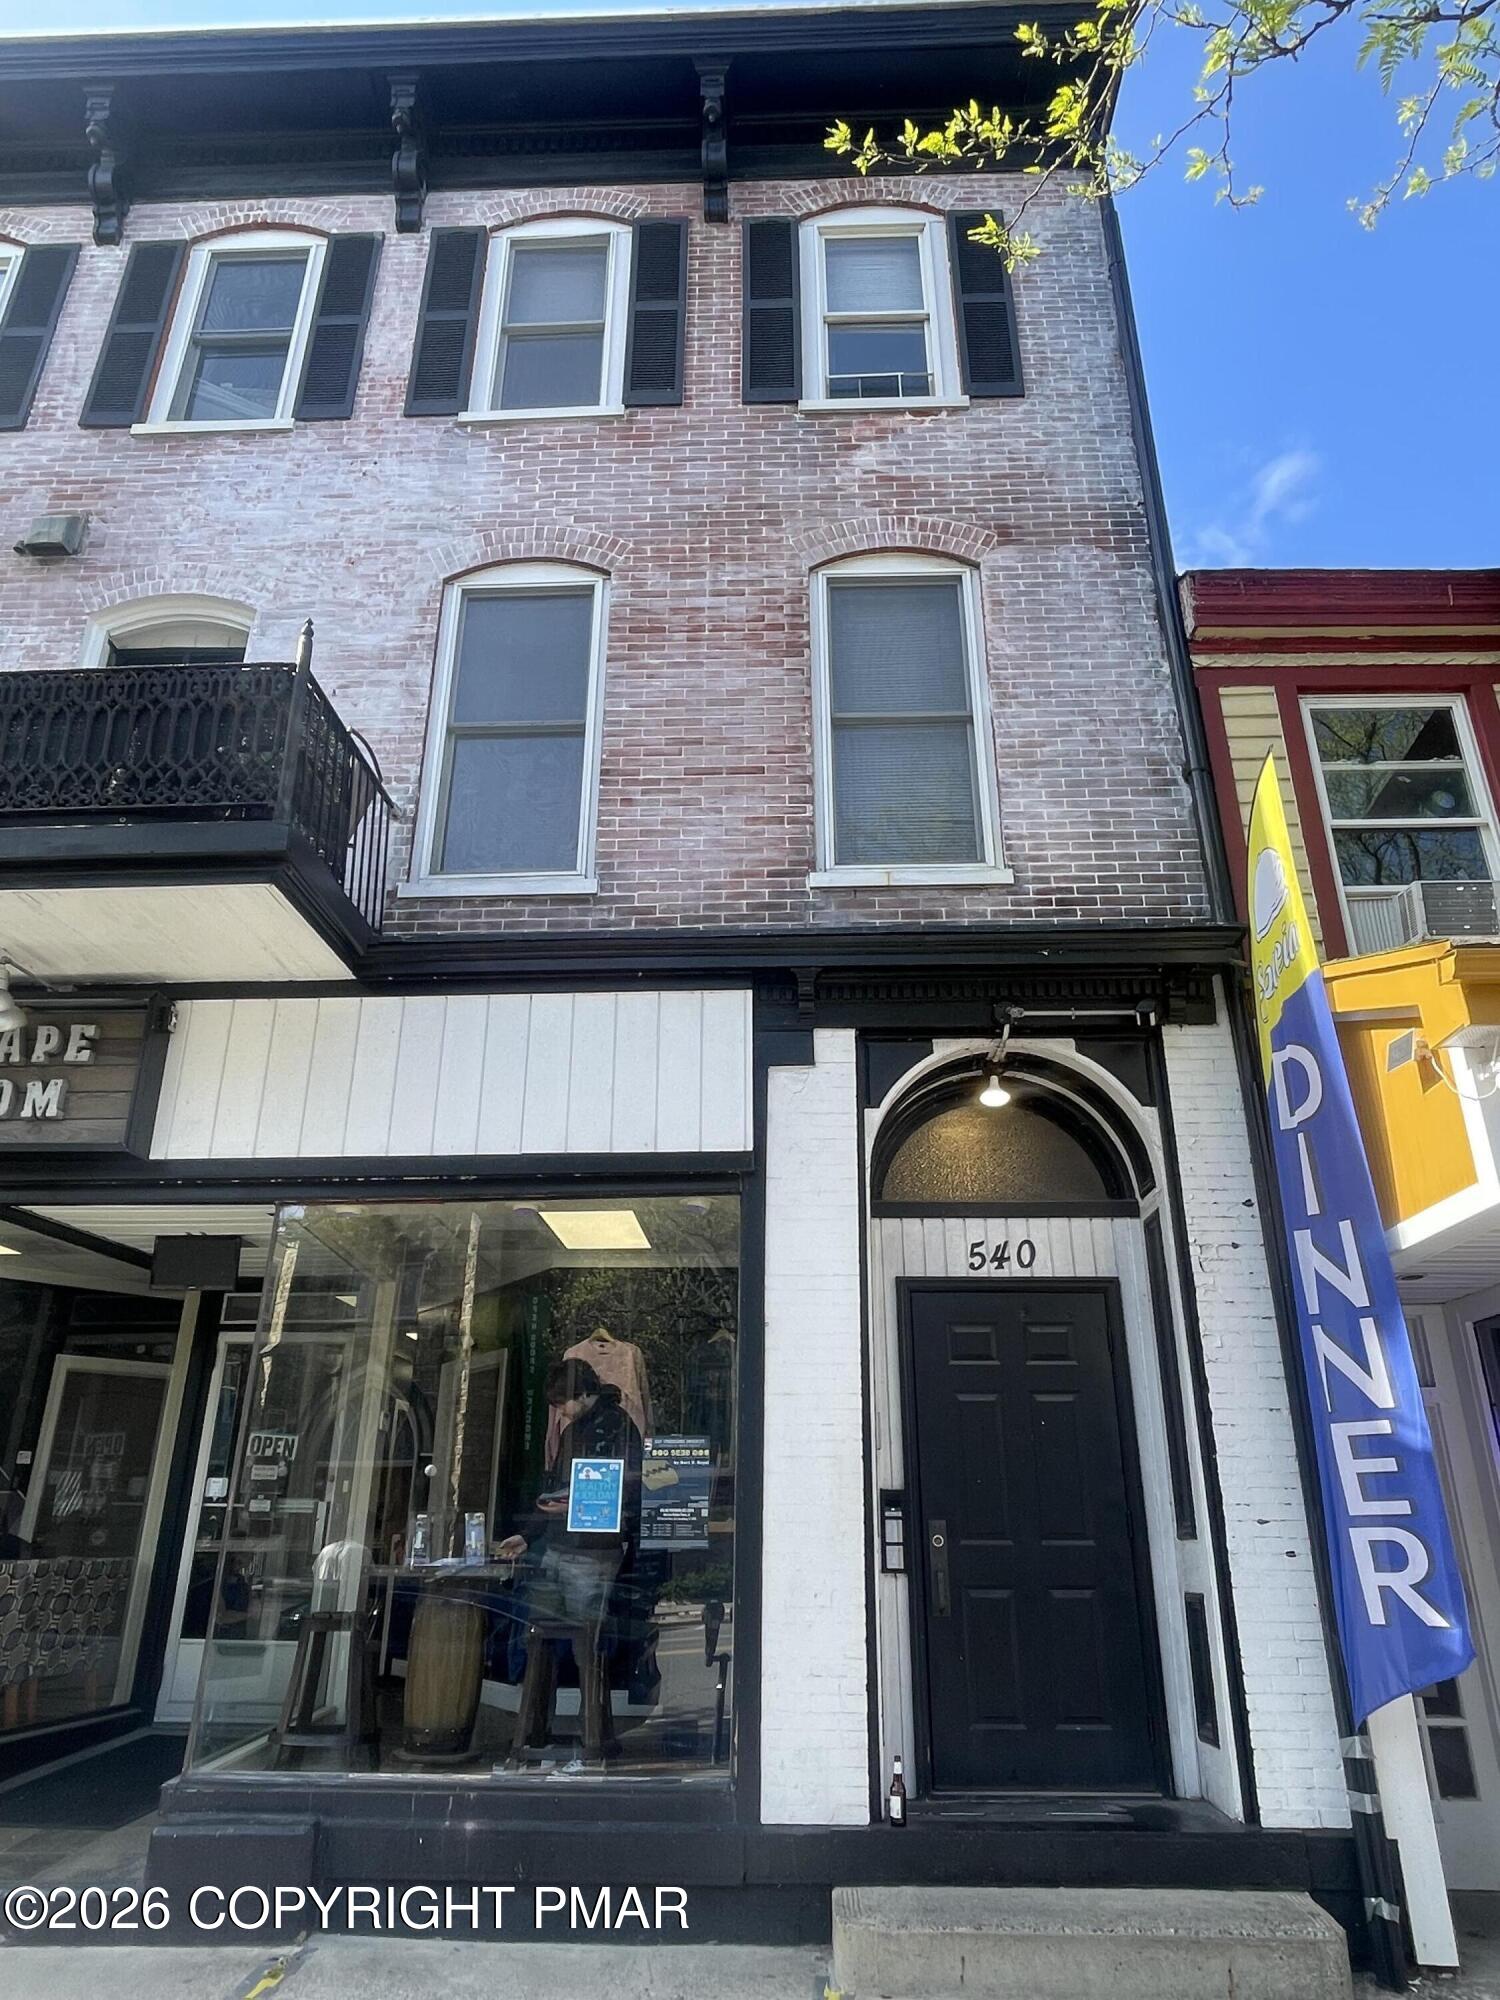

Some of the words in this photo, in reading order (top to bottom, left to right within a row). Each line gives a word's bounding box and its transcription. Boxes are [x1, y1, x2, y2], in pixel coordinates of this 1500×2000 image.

[968, 1239, 1036, 1271] 540
[1272, 1044, 1451, 1628] DINNER
[249, 1435, 296, 1459] OPEN
